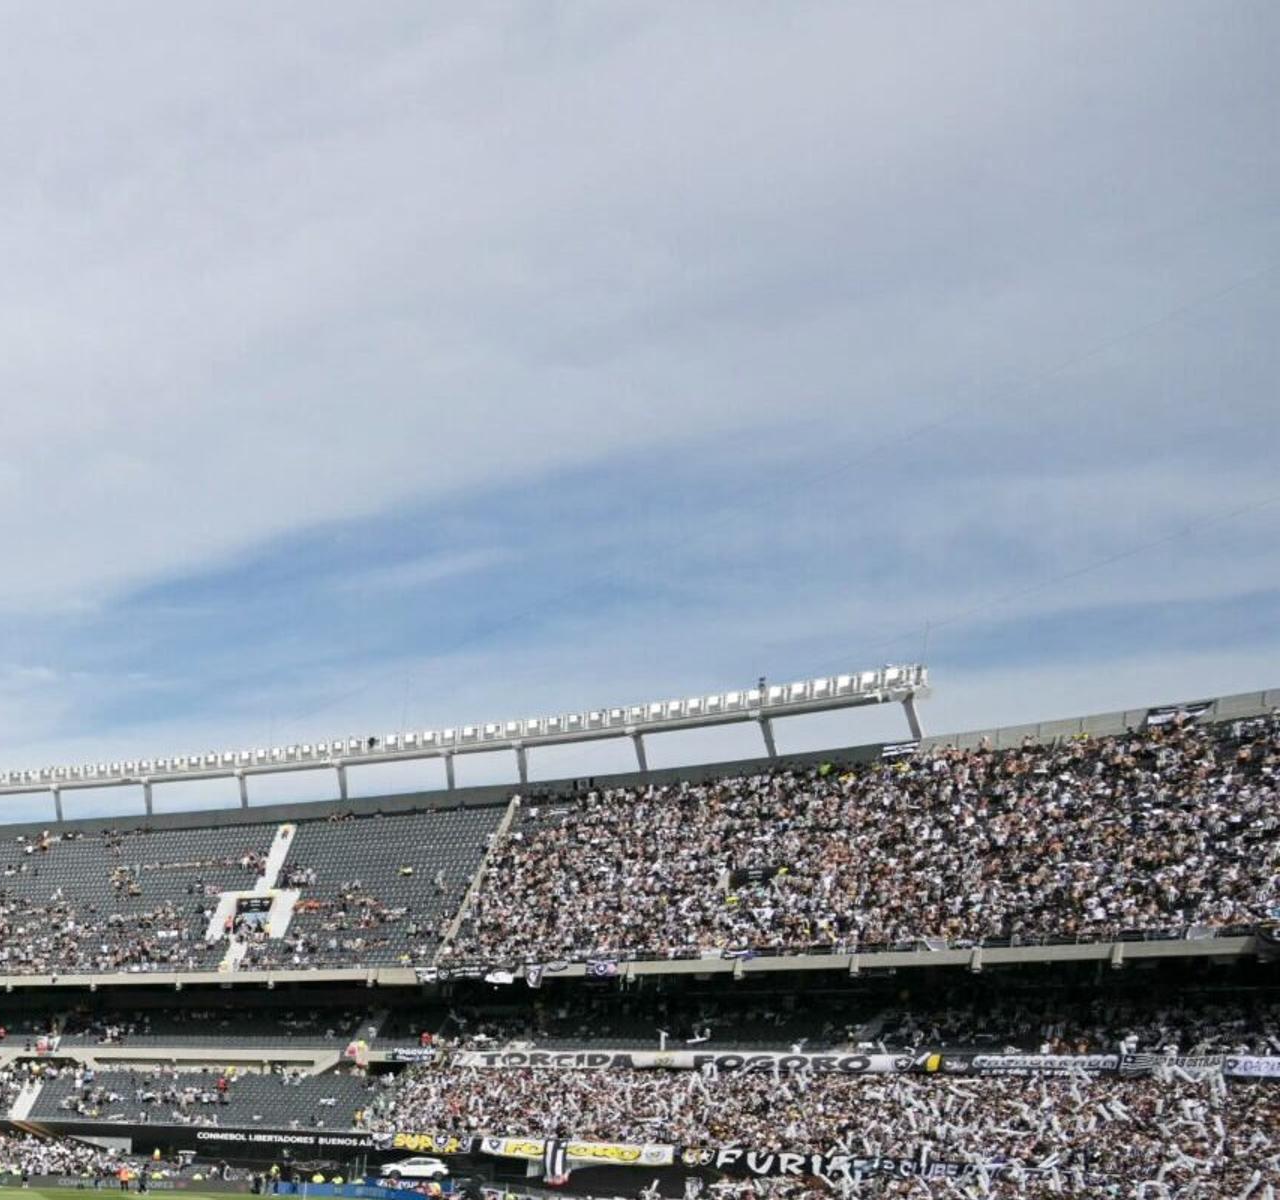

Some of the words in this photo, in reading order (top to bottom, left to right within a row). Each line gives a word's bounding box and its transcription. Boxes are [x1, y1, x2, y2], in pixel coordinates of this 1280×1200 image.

[481, 1051, 635, 1069] TORCIDA
[197, 1131, 247, 1142] CONMEBOL
[249, 1133, 314, 1145] LIBERTADORES
[318, 1136, 357, 1147] BUENOS
